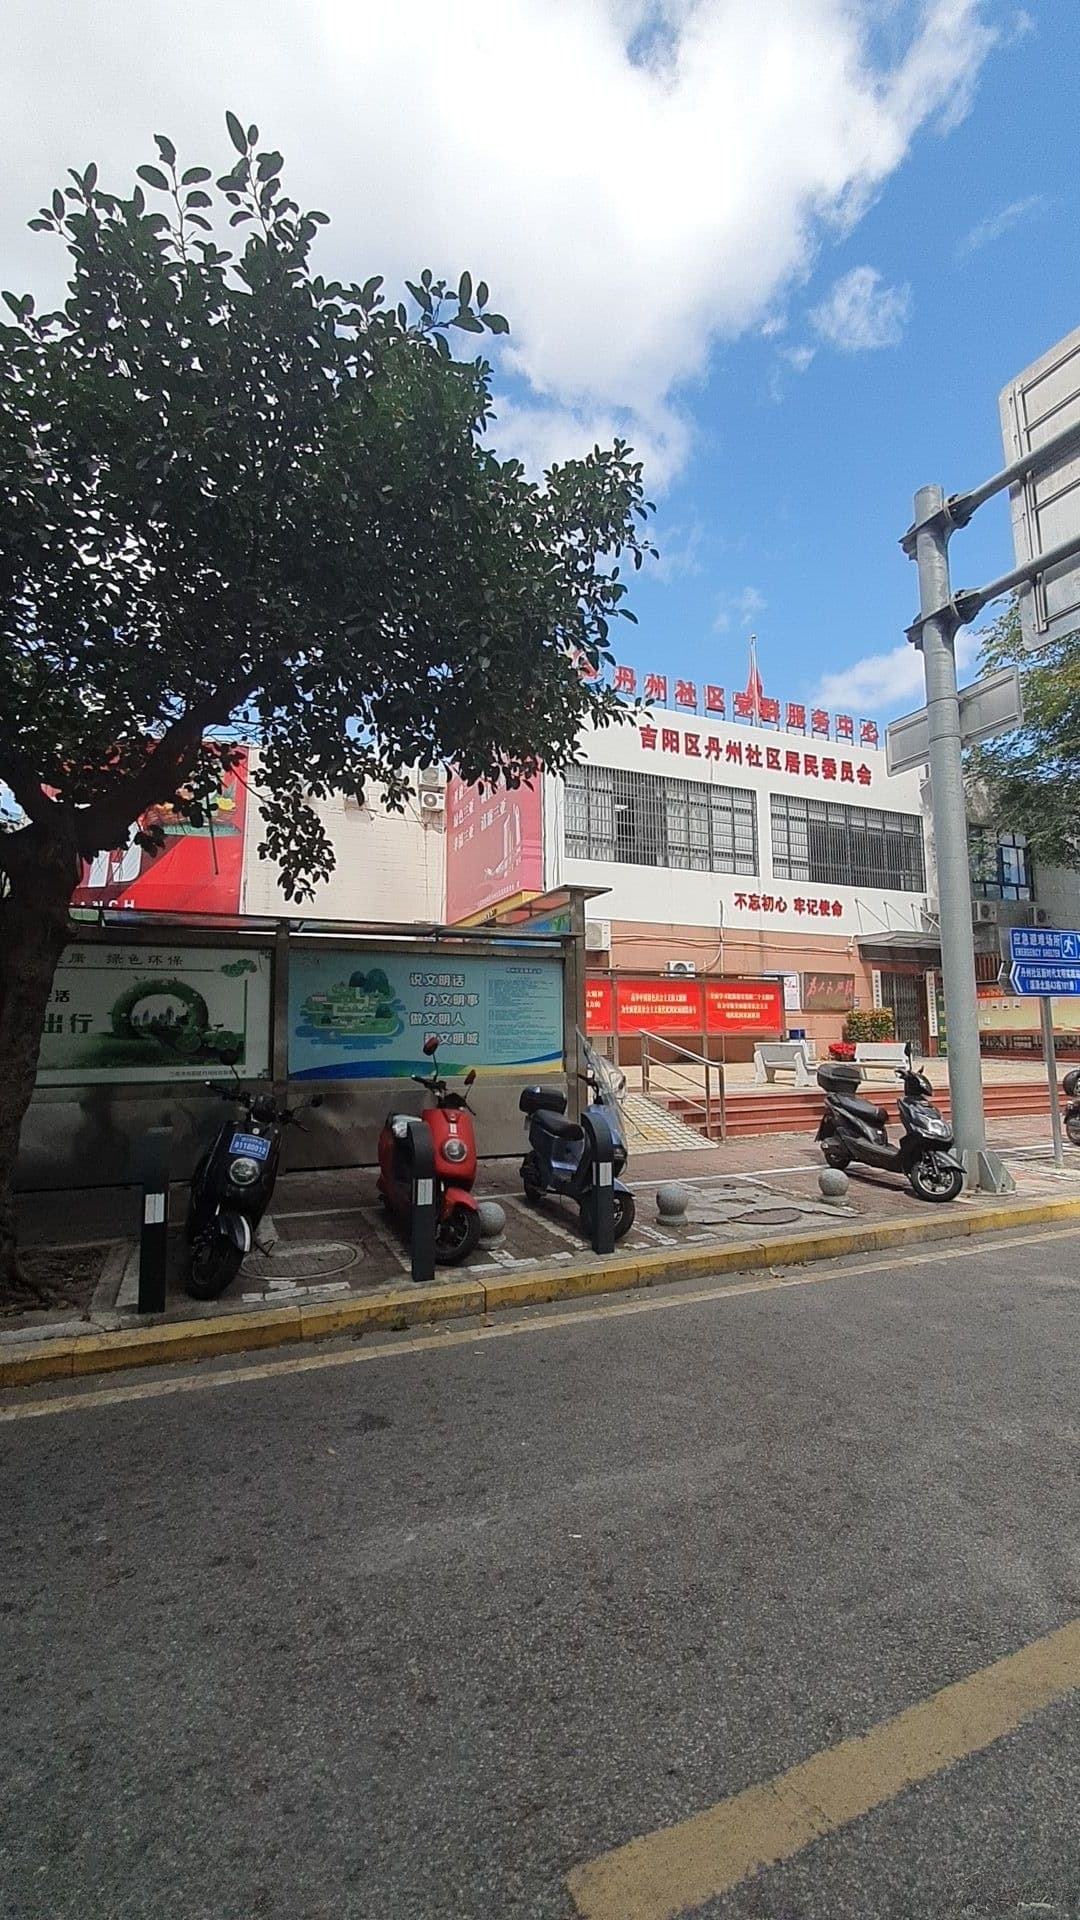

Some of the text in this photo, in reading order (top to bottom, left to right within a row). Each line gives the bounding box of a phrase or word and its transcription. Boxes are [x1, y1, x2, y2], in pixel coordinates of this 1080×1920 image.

[639, 724, 872, 786] 吉阳区丹州社区居民委员会
[734, 892, 843, 918] 不忘初心 牢记使命
[410, 973, 465, 987] 说文明话
[424, 993, 480, 1007] 办文明事
[410, 1012, 465, 1026] 做文明人
